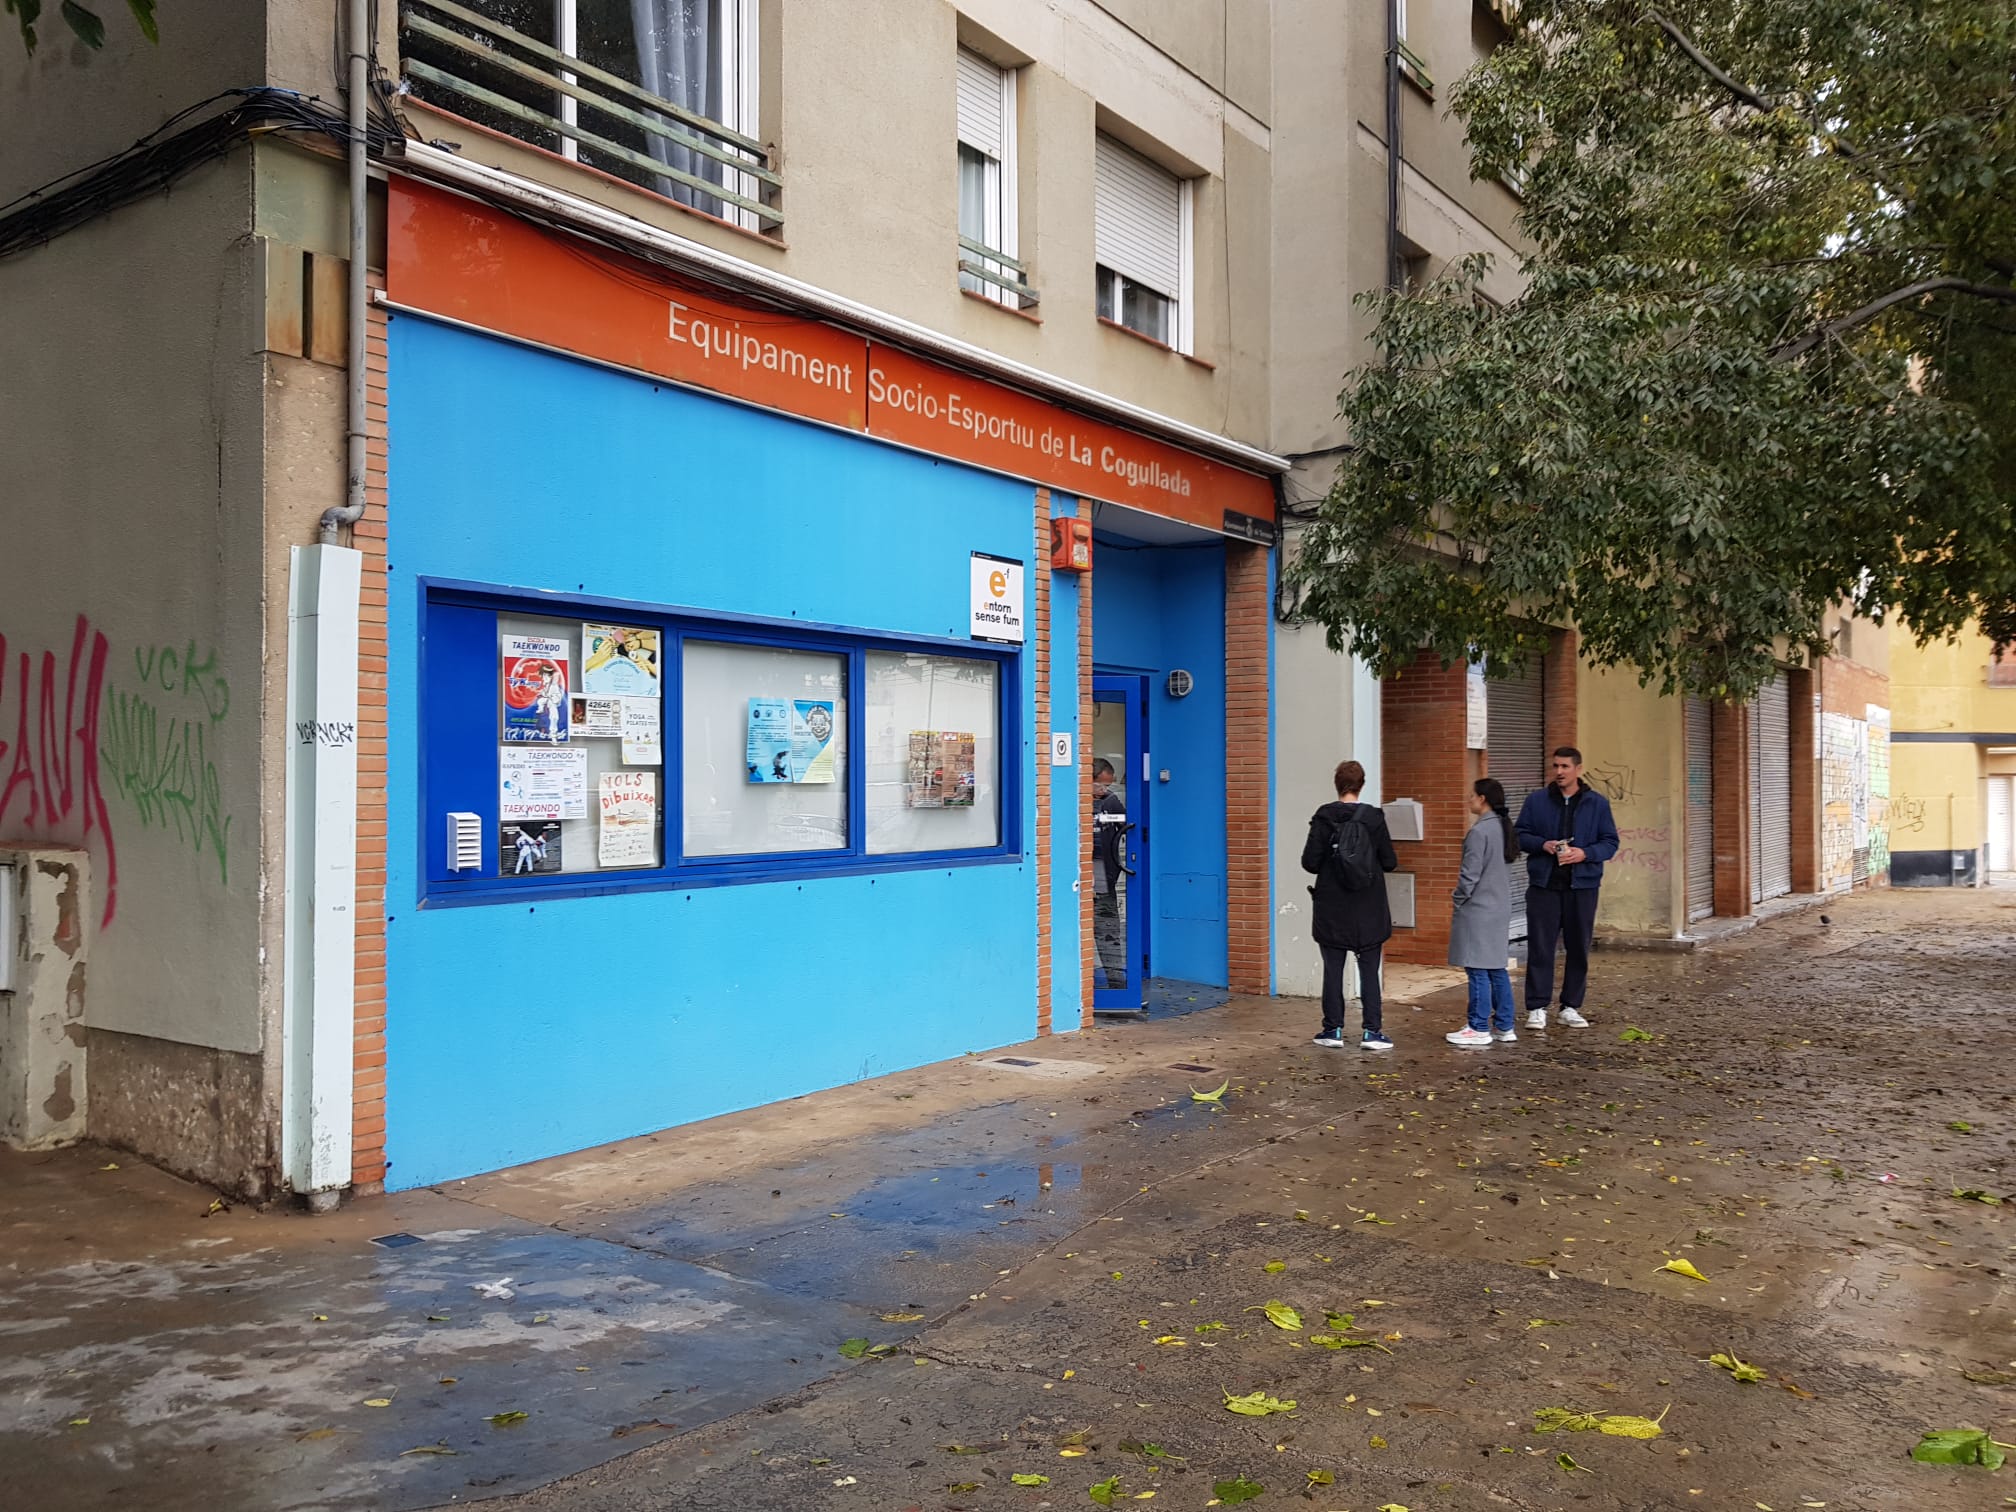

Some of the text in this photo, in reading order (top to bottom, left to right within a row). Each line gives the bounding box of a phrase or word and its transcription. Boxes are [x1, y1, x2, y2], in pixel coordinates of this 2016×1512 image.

[669, 301, 1191, 497] Equipament Socio-Esportiu de La Cogullada
[984, 601, 1012, 614] entorn
[975, 611, 1020, 627] sense fum
[512, 641, 561, 652] TAEKWONDO
[528, 752, 574, 760] TAEKWONDO
